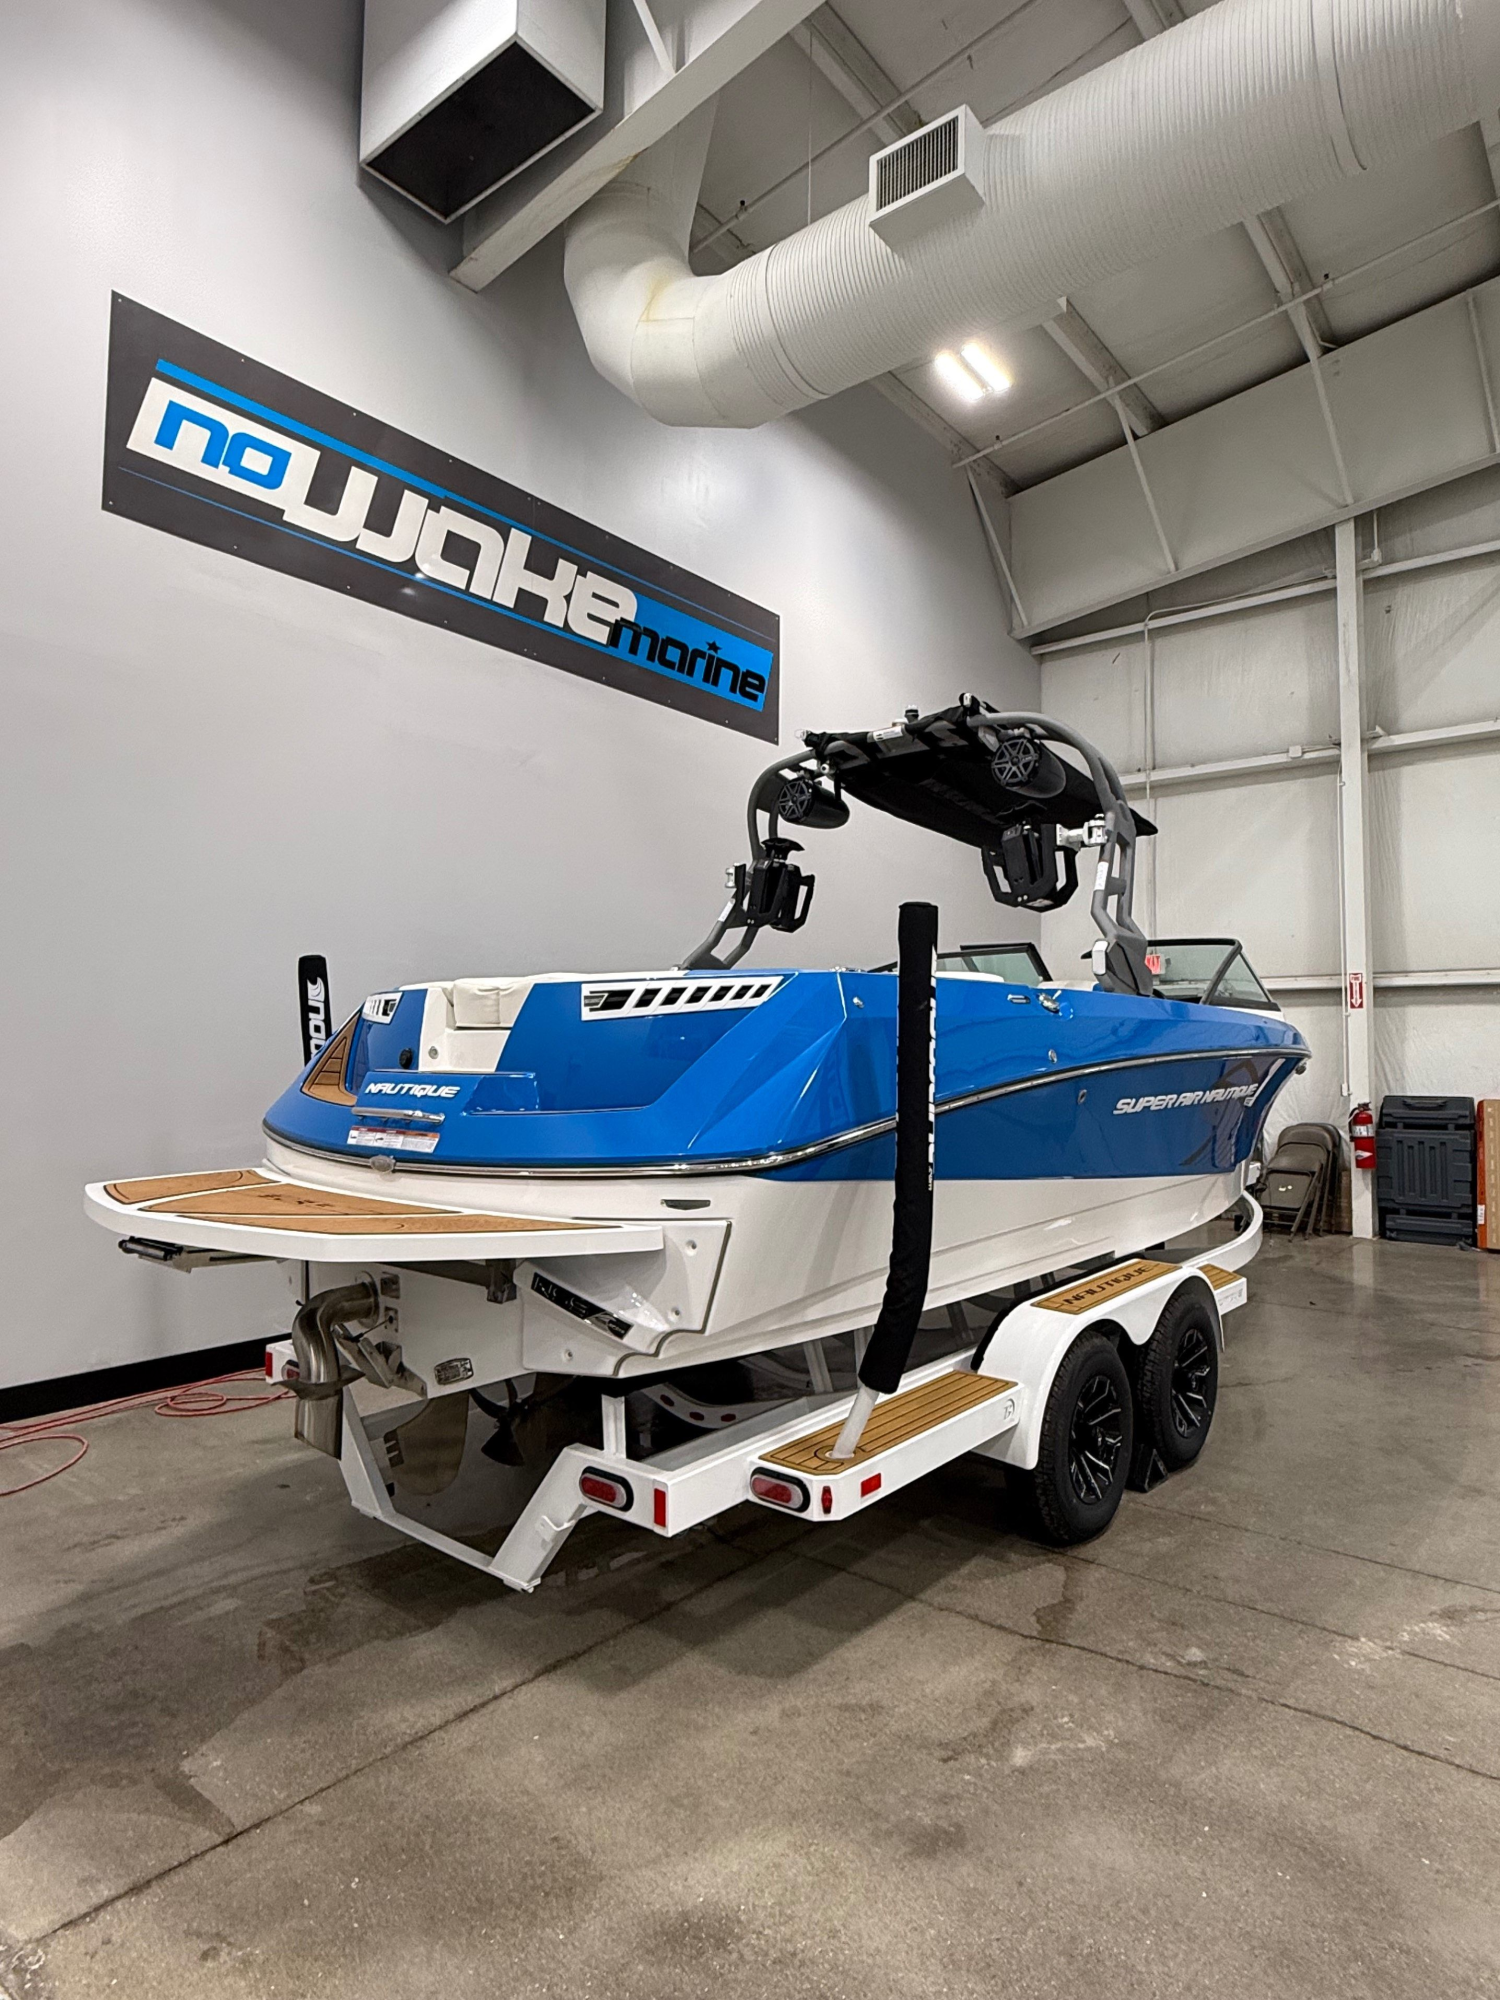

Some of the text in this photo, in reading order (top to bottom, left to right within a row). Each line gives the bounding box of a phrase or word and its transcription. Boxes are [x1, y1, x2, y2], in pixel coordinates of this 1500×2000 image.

[608, 617, 767, 702] marine
[365, 1082, 460, 1097] NAUTIQUE
[1112, 1094, 1178, 1115] SUPER
[1174, 1091, 1202, 1107] AIR
[1201, 1083, 1259, 1104] NAUTIQUE
[1063, 1264, 1151, 1306] NAUTIQUE
